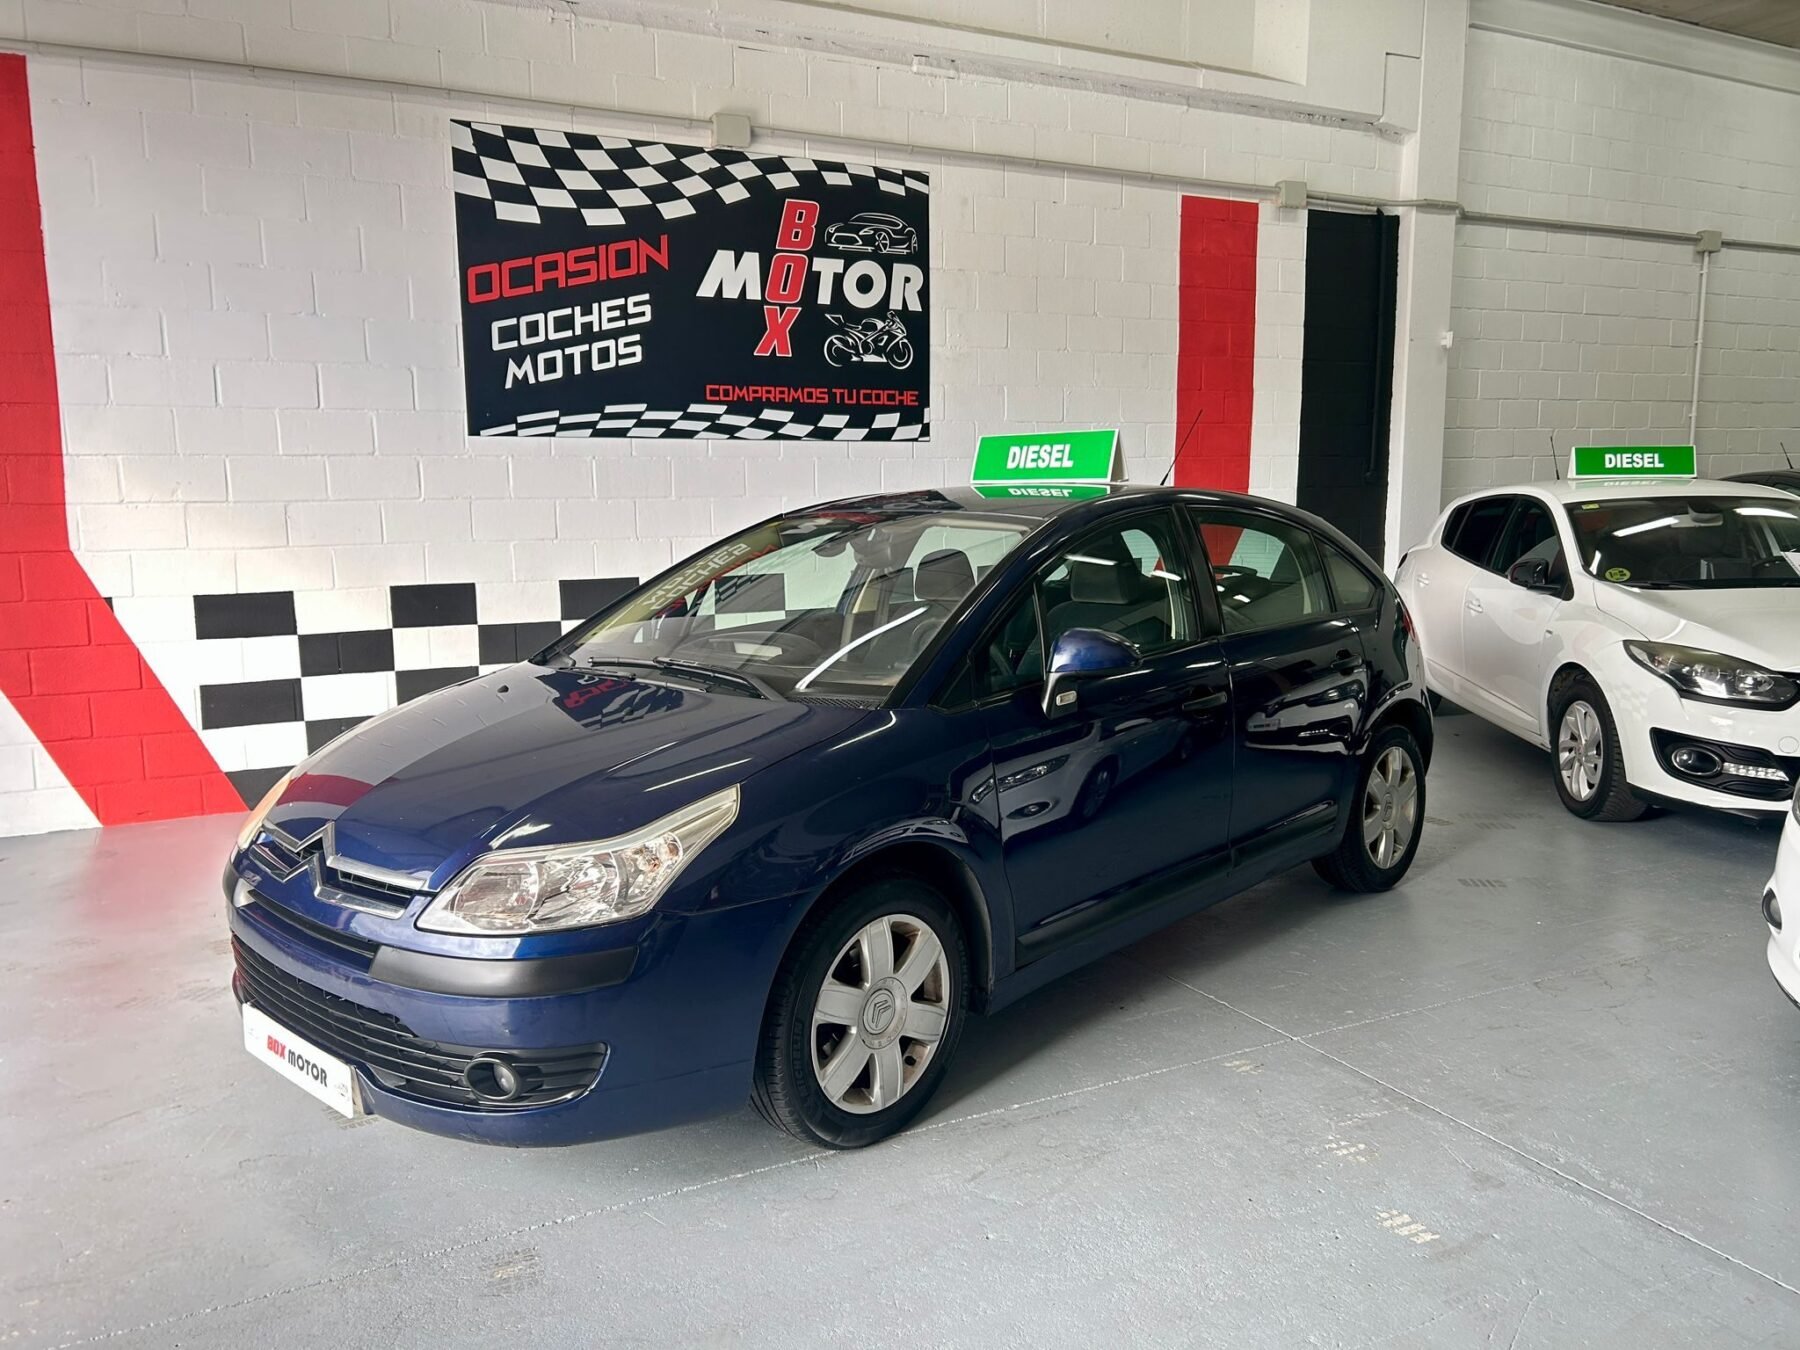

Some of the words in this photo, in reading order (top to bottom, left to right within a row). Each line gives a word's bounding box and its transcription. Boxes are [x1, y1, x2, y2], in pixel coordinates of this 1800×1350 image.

[467, 234, 669, 304] OCASION
[696, 249, 924, 312] MOTOR
[753, 198, 820, 357] BOX
[491, 293, 652, 351] COCHES
[504, 333, 643, 389] MOTOS
[705, 384, 829, 404] COMPRAMOS
[832, 388, 856, 405] TU
[859, 389, 919, 406] COCHE
[1006, 443, 1074, 469] DIESEL
[1604, 453, 1664, 469] DIESEL
[266, 1035, 286, 1060] BOX
[288, 1048, 328, 1088] MOTOR
